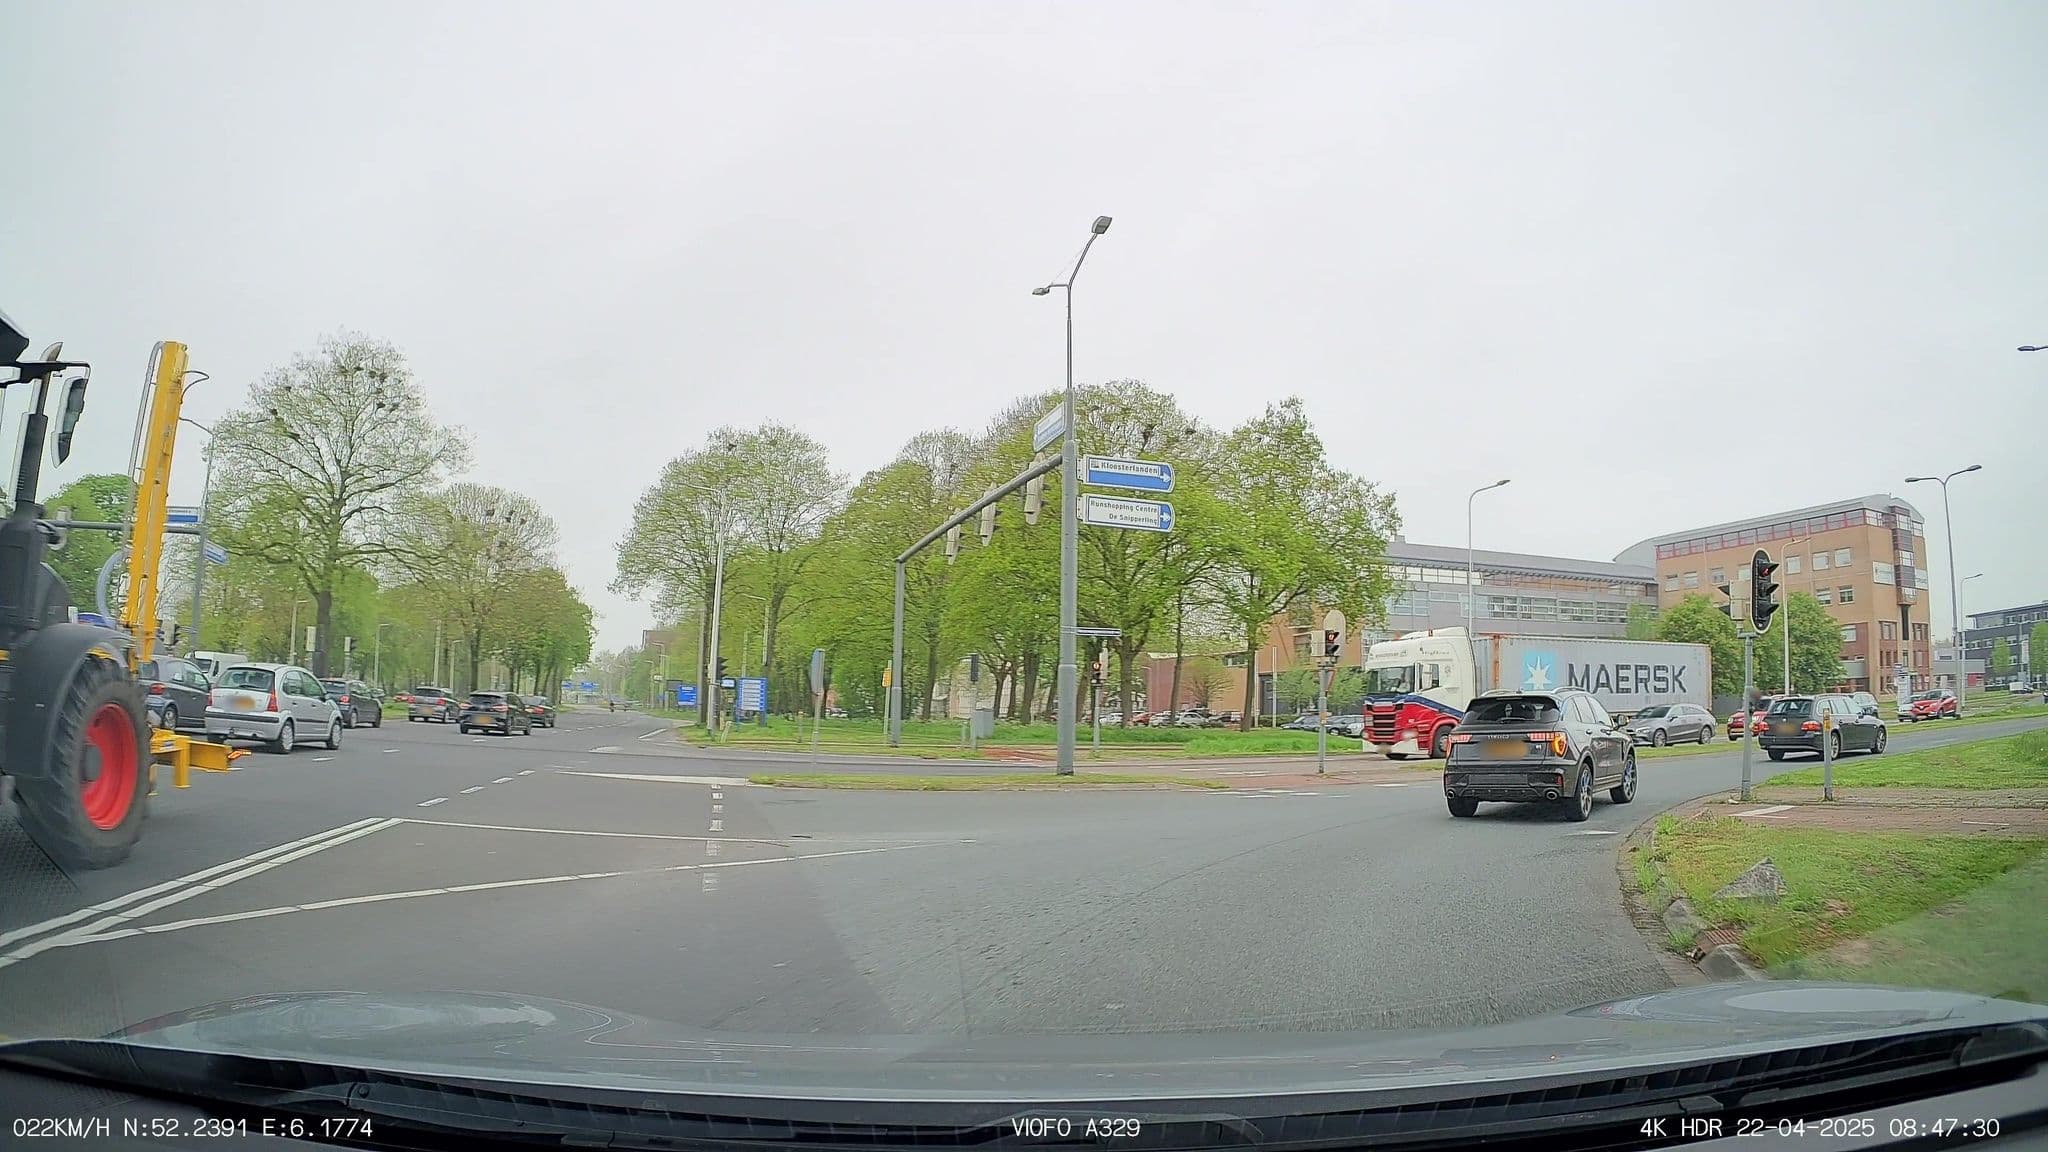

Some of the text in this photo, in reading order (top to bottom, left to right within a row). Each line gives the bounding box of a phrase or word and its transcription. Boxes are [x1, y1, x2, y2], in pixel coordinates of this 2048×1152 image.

[1101, 461, 1158, 474] Kloosterlanden
[1090, 500, 1158, 513] Runshopping Centre
[1119, 514, 1158, 526] Snipperling
[1567, 663, 1687, 694] MAERSK
